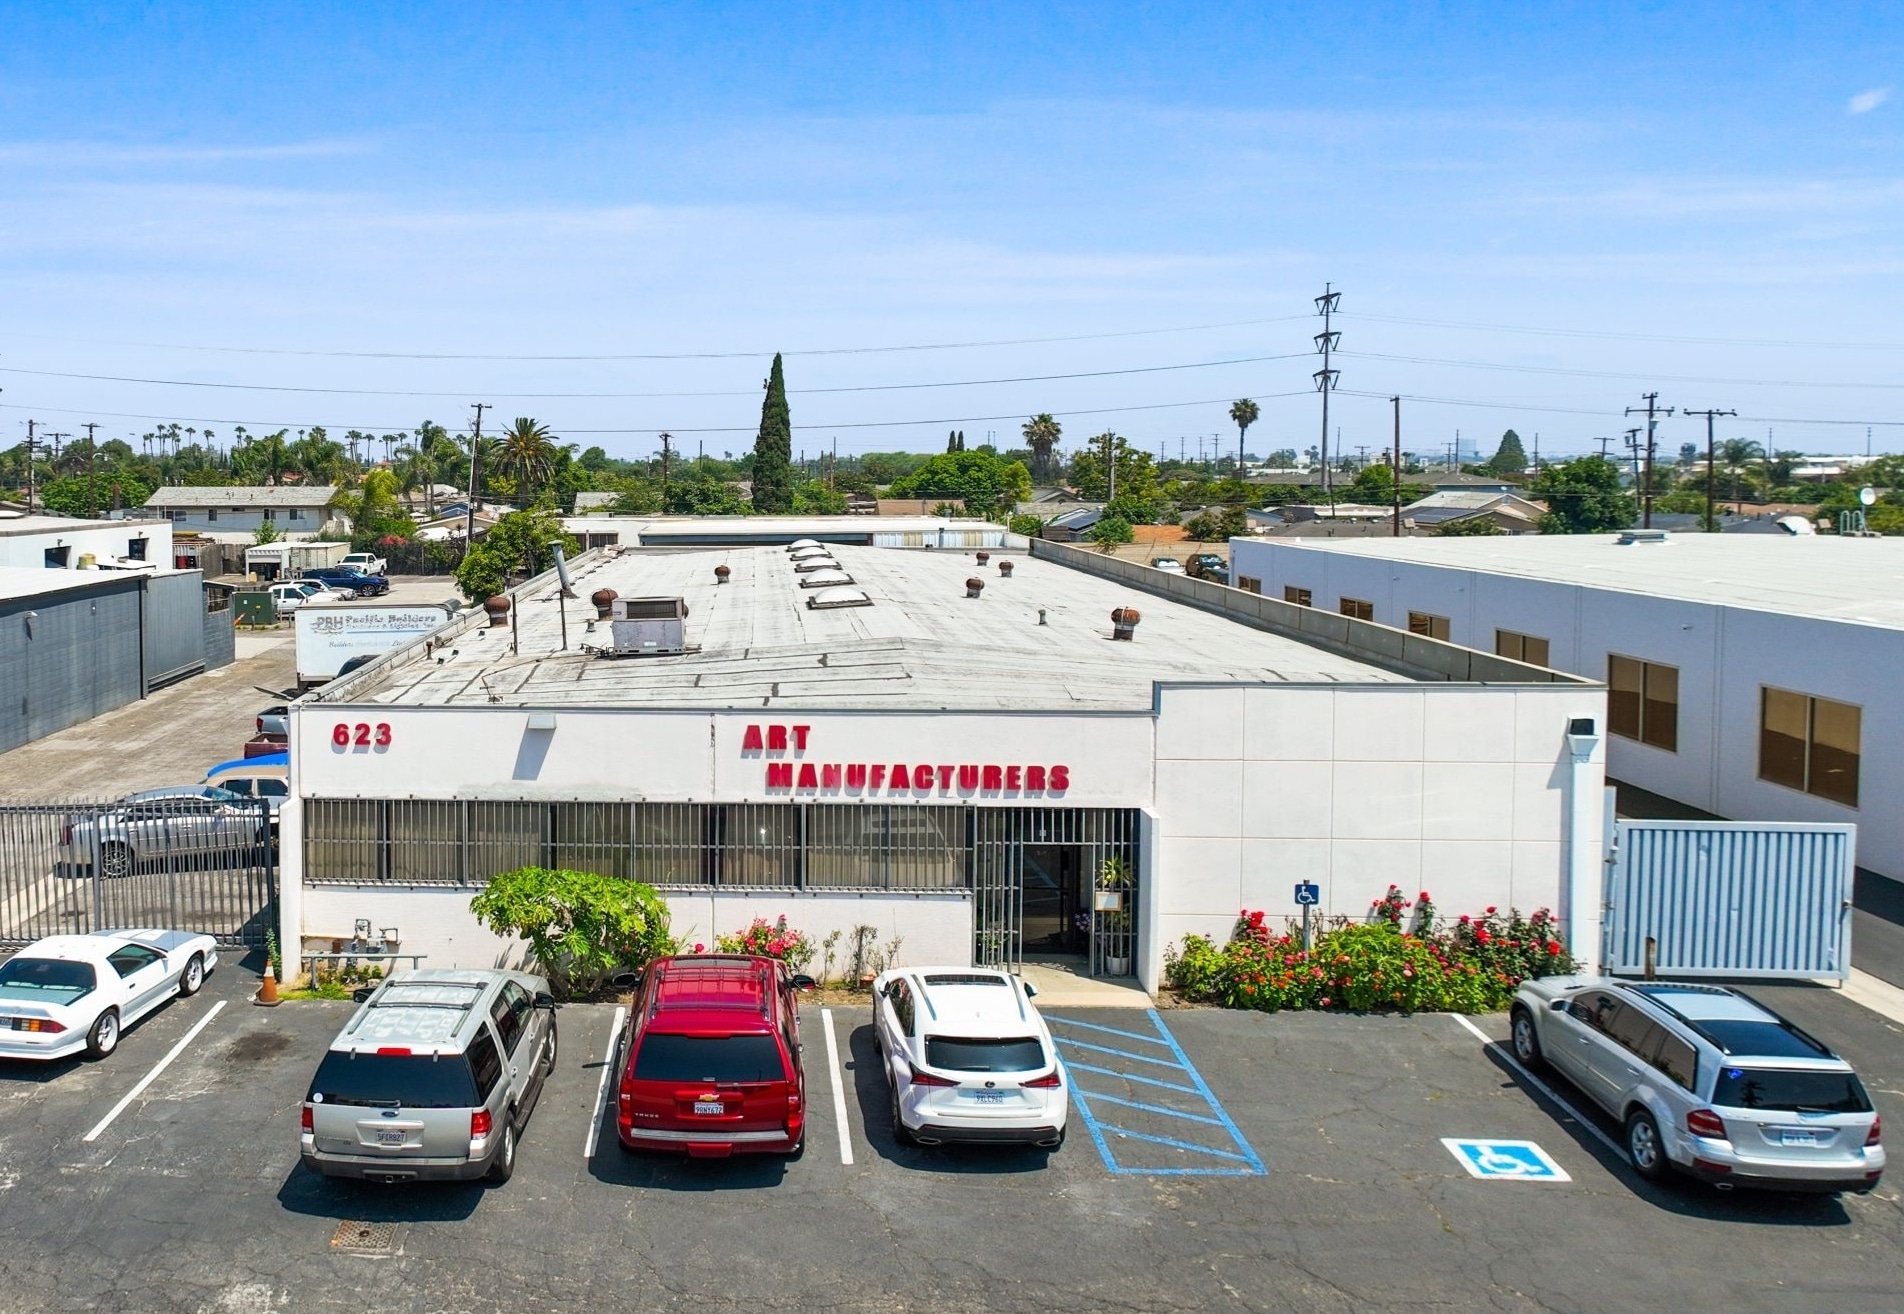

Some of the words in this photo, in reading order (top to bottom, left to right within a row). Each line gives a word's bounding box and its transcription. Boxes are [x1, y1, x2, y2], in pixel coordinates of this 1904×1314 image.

[333, 723, 392, 746] 623
[743, 725, 811, 750] ART
[768, 763, 1070, 791] MANUFACTURERS
